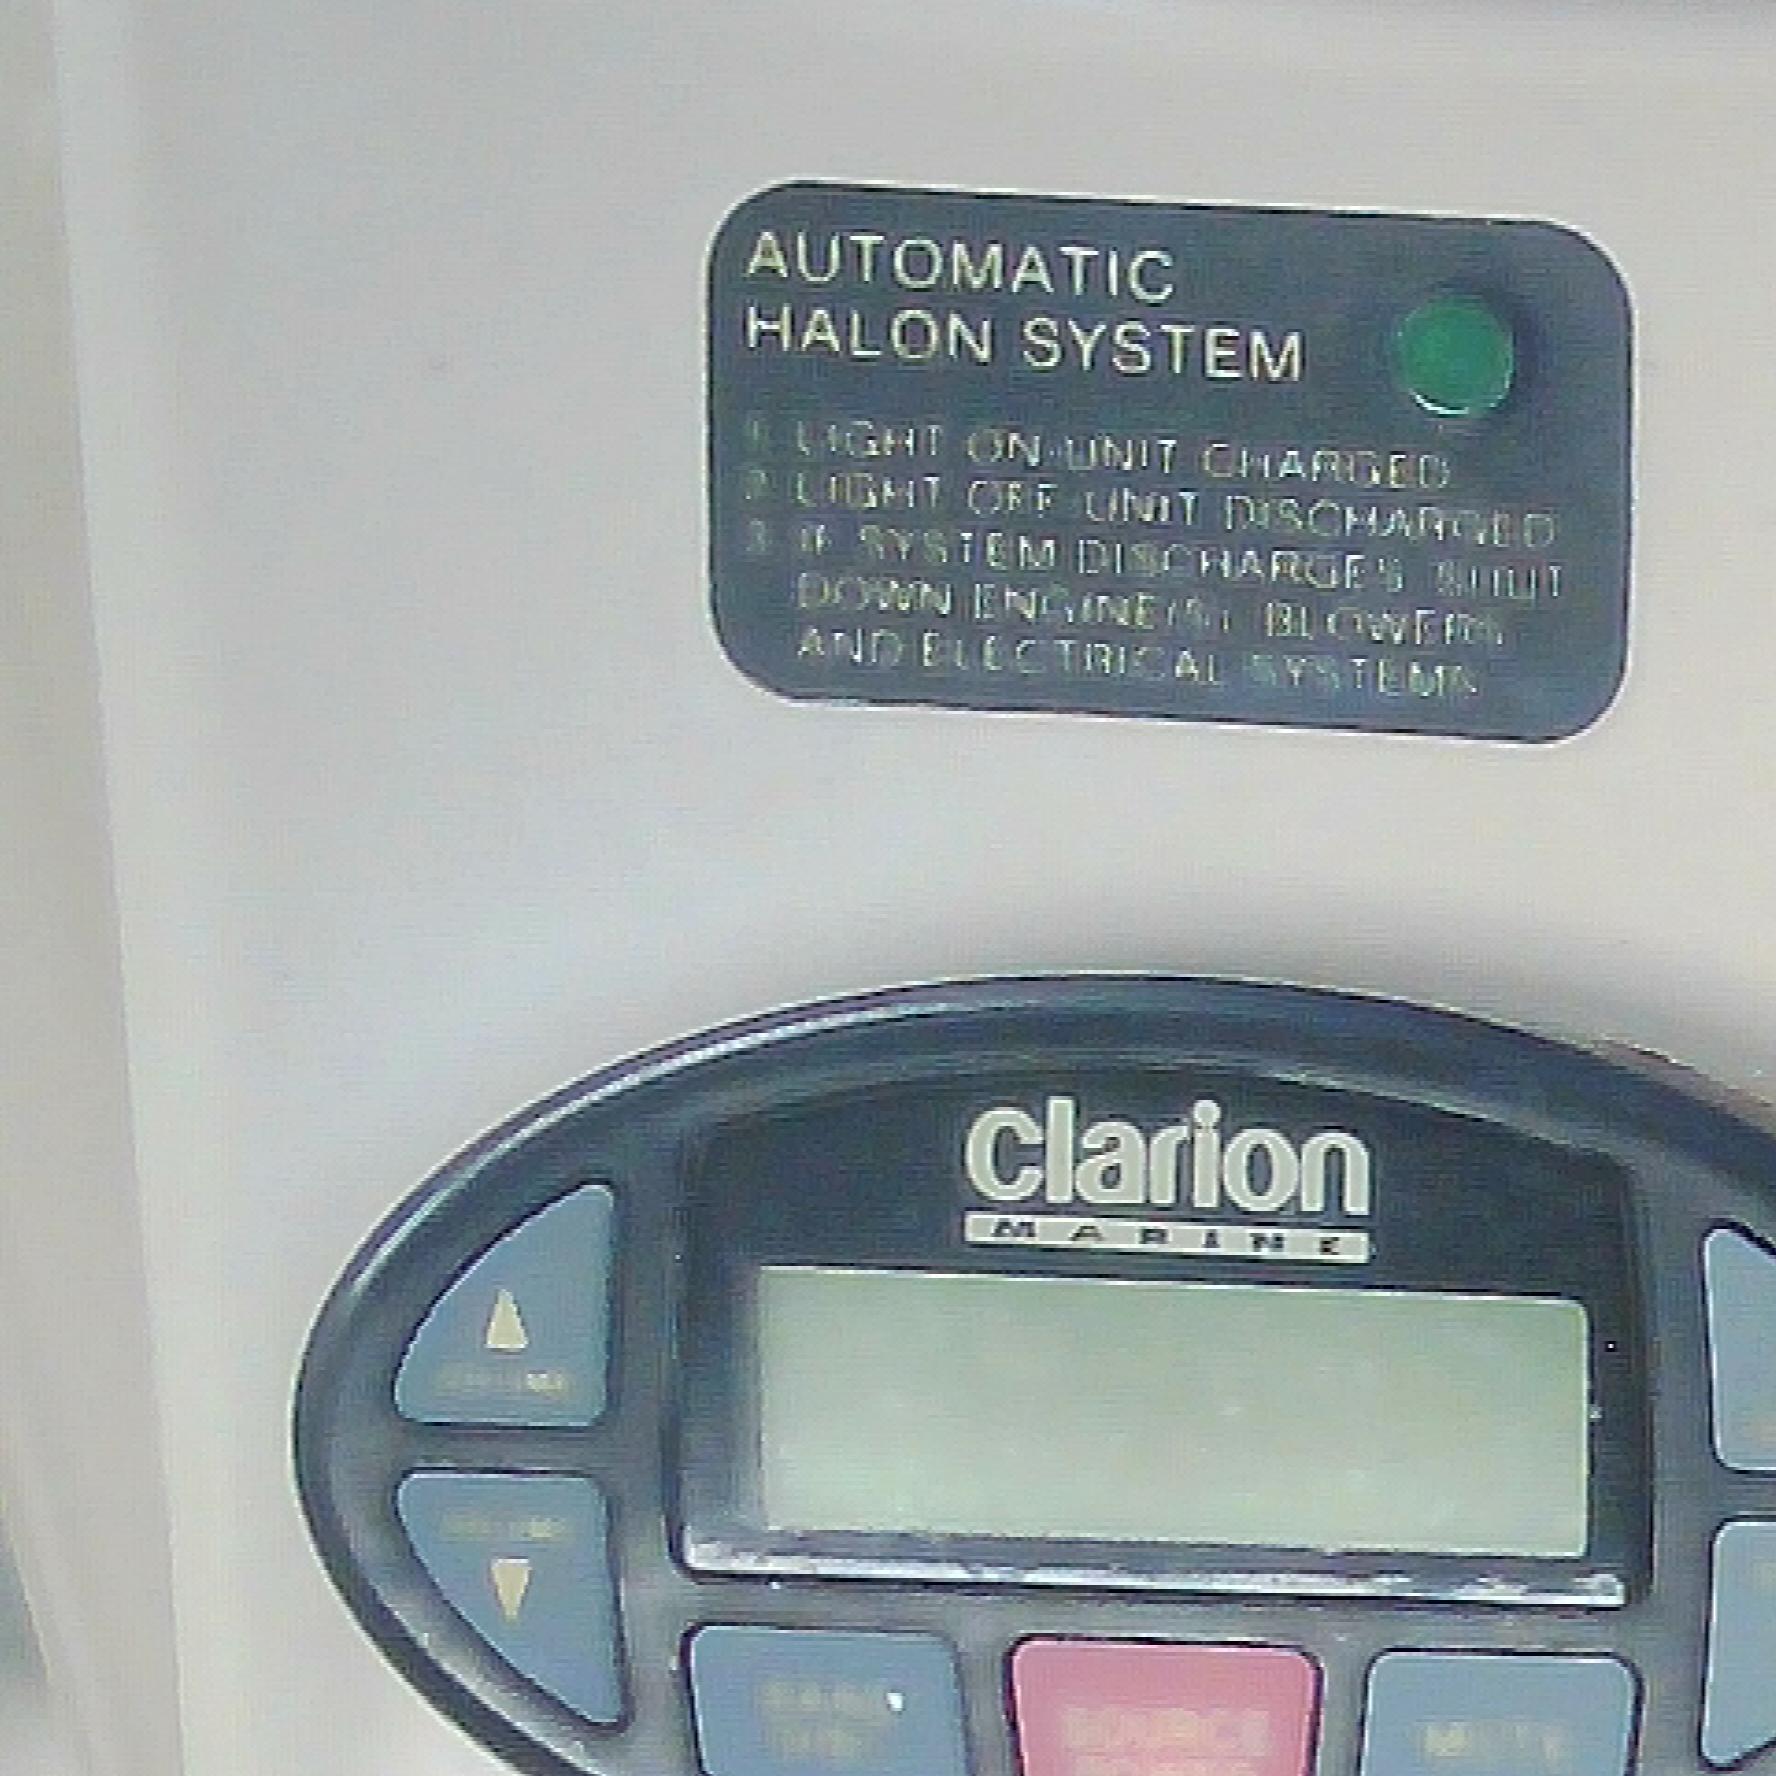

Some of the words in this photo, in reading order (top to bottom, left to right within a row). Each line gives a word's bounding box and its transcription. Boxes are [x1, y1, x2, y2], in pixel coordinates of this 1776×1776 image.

[747, 232, 1175, 304] AUTOMATIC
[748, 305, 993, 363] HALON
[1022, 317, 1302, 382] SYSTEM
[798, 420, 943, 457] LIGHT
[1204, 443, 1451, 488] CHARGED
[798, 472, 941, 508] LIGHT
[861, 523, 1056, 569] SYSTEM
[992, 1220, 1341, 1256] MARINE
